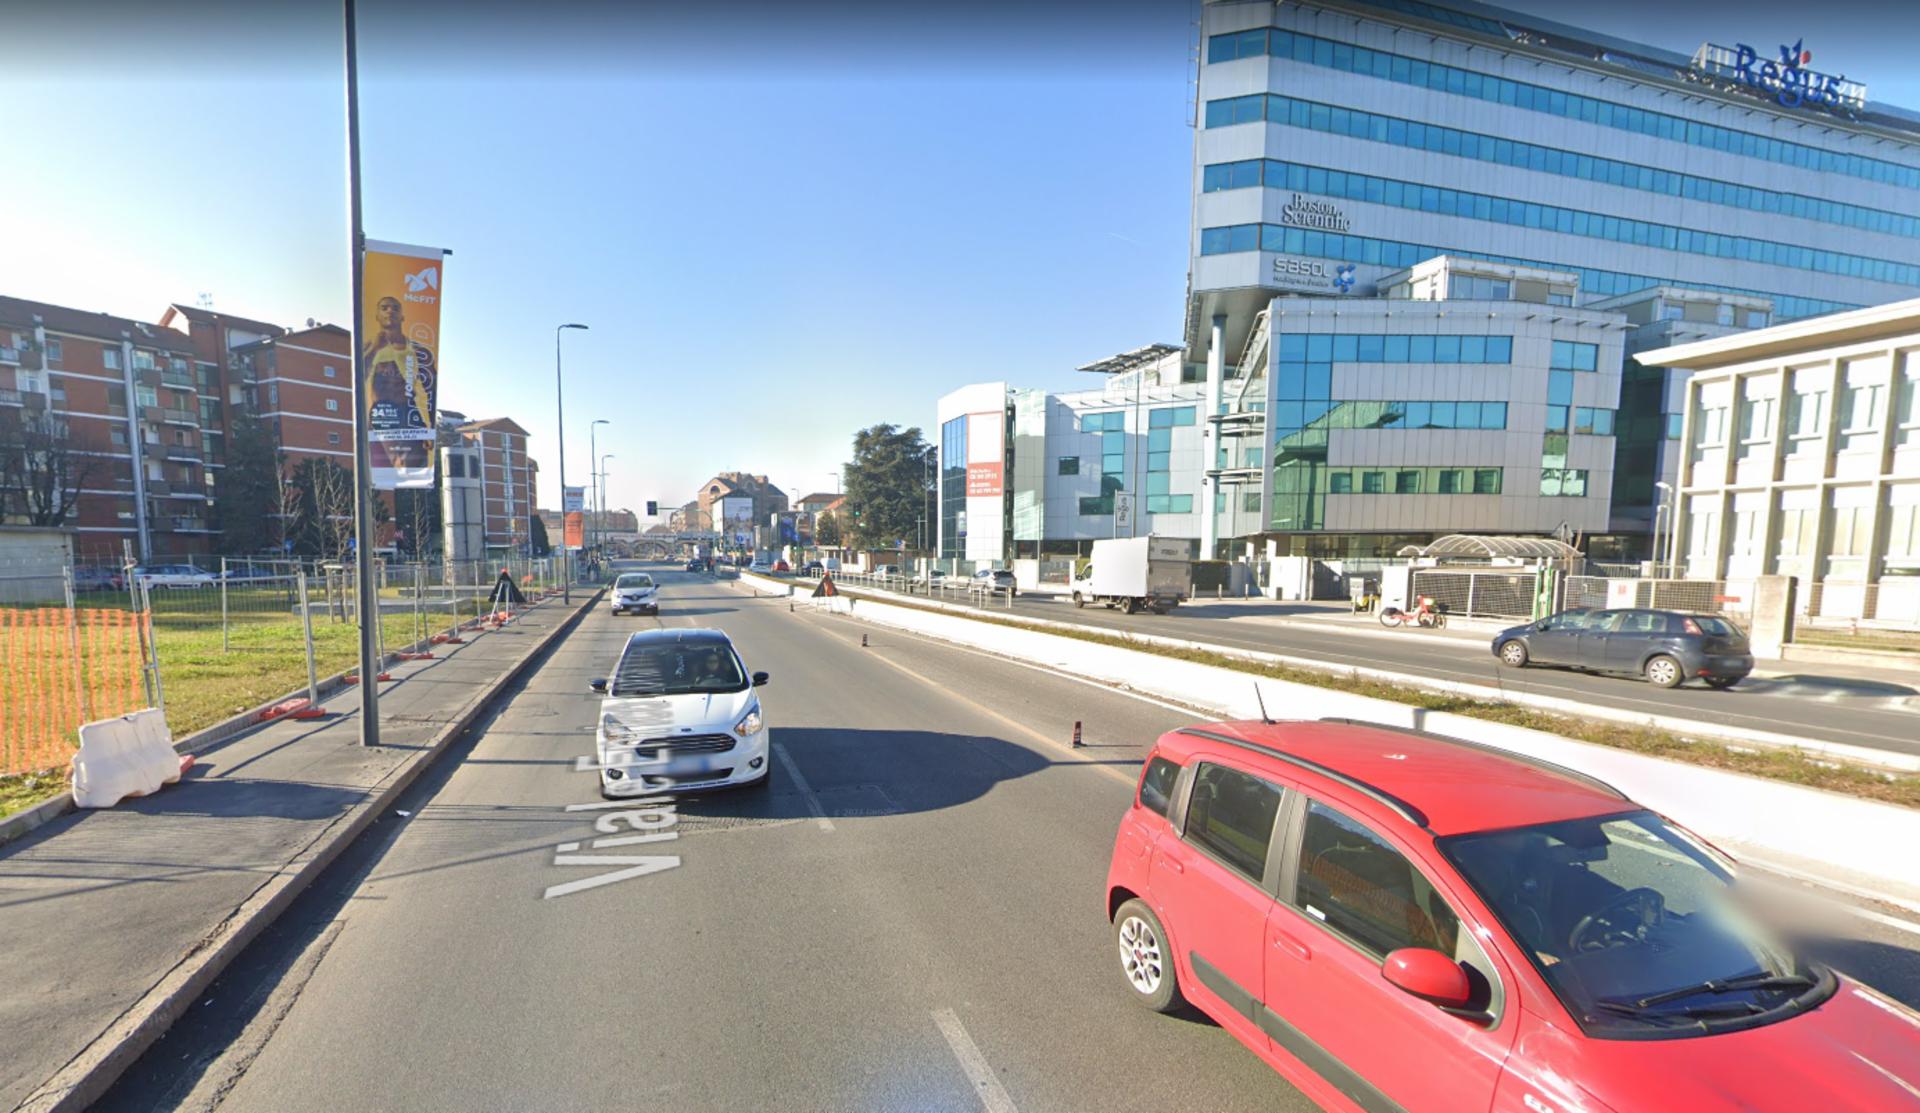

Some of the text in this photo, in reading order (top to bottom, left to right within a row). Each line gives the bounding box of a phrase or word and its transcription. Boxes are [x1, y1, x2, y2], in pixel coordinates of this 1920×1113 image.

[1734, 43, 1841, 108] Regus
[1282, 204, 1352, 232] Scientific
[1292, 193, 1338, 216] Boston
[404, 355, 414, 397] FOREVER
[407, 321, 435, 428] PROUD
